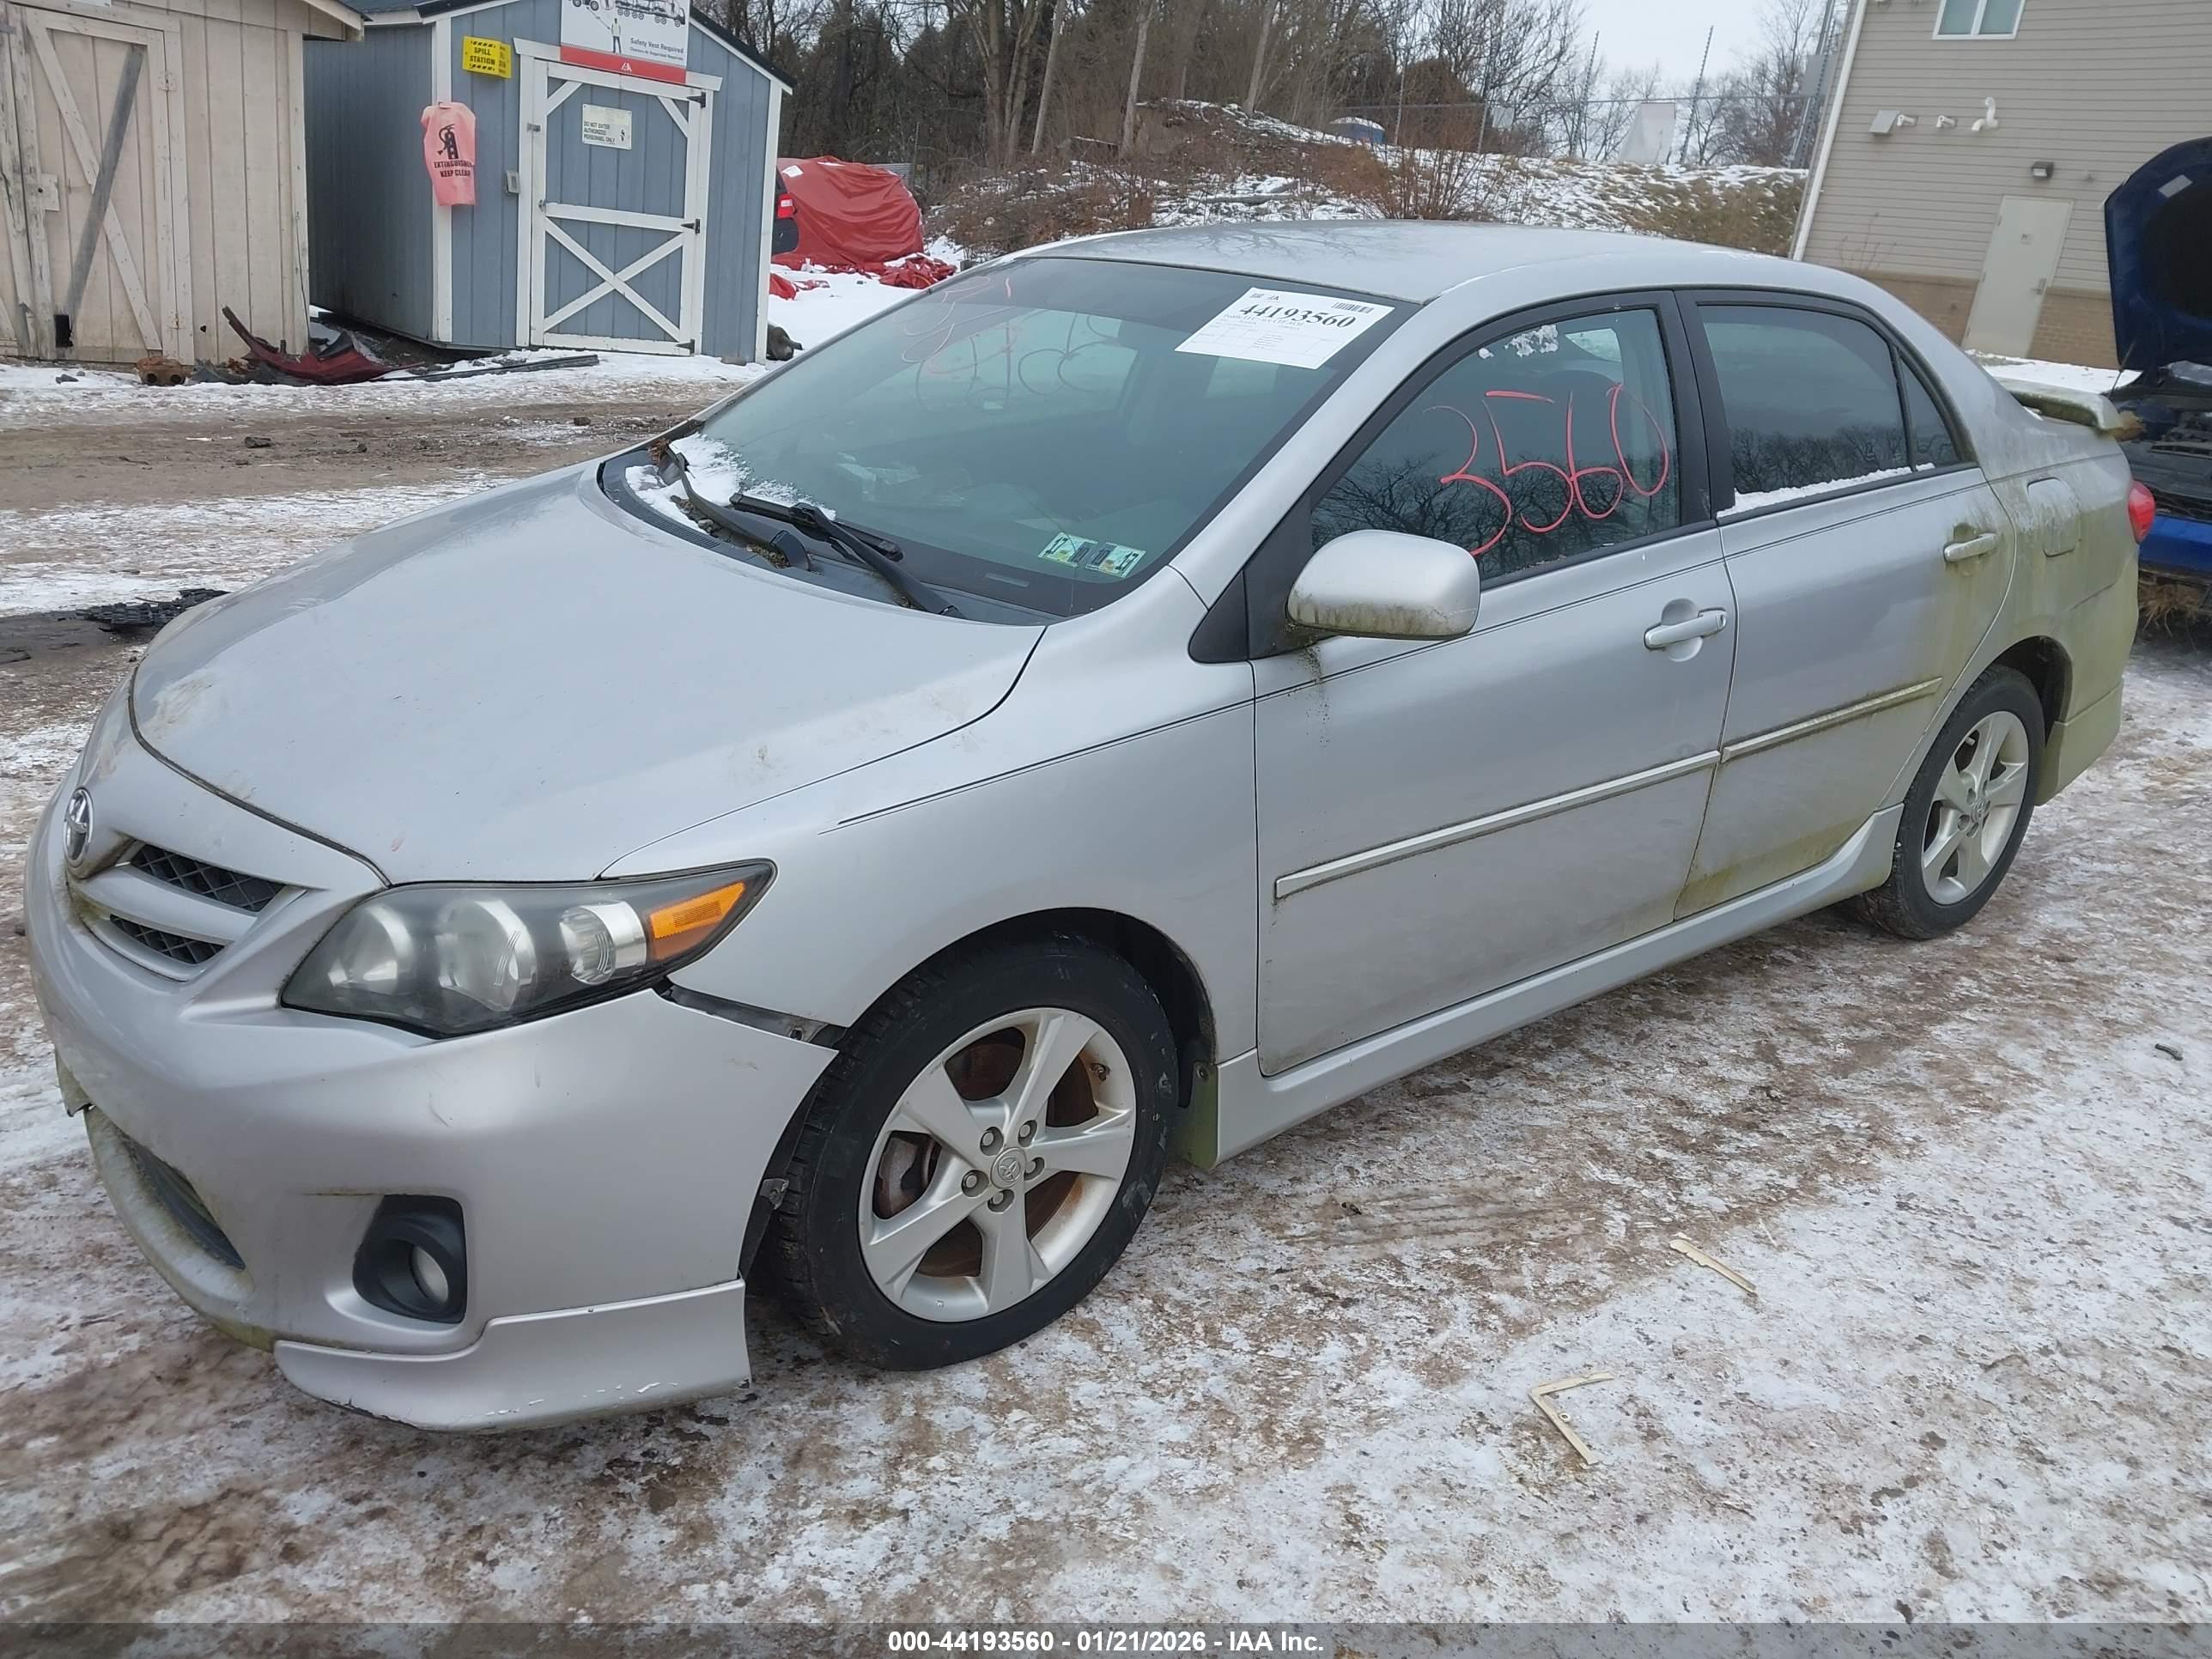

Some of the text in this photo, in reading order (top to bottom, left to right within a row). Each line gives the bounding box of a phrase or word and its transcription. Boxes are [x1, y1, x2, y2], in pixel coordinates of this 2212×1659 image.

[474, 46, 491, 56] SPILL
[630, 37, 647, 47] Safety
[660, 43, 684, 53] Required
[470, 55, 495, 65] STATION
[1238, 303, 1357, 329] 44193560
[1422, 383, 1670, 556] 3560
